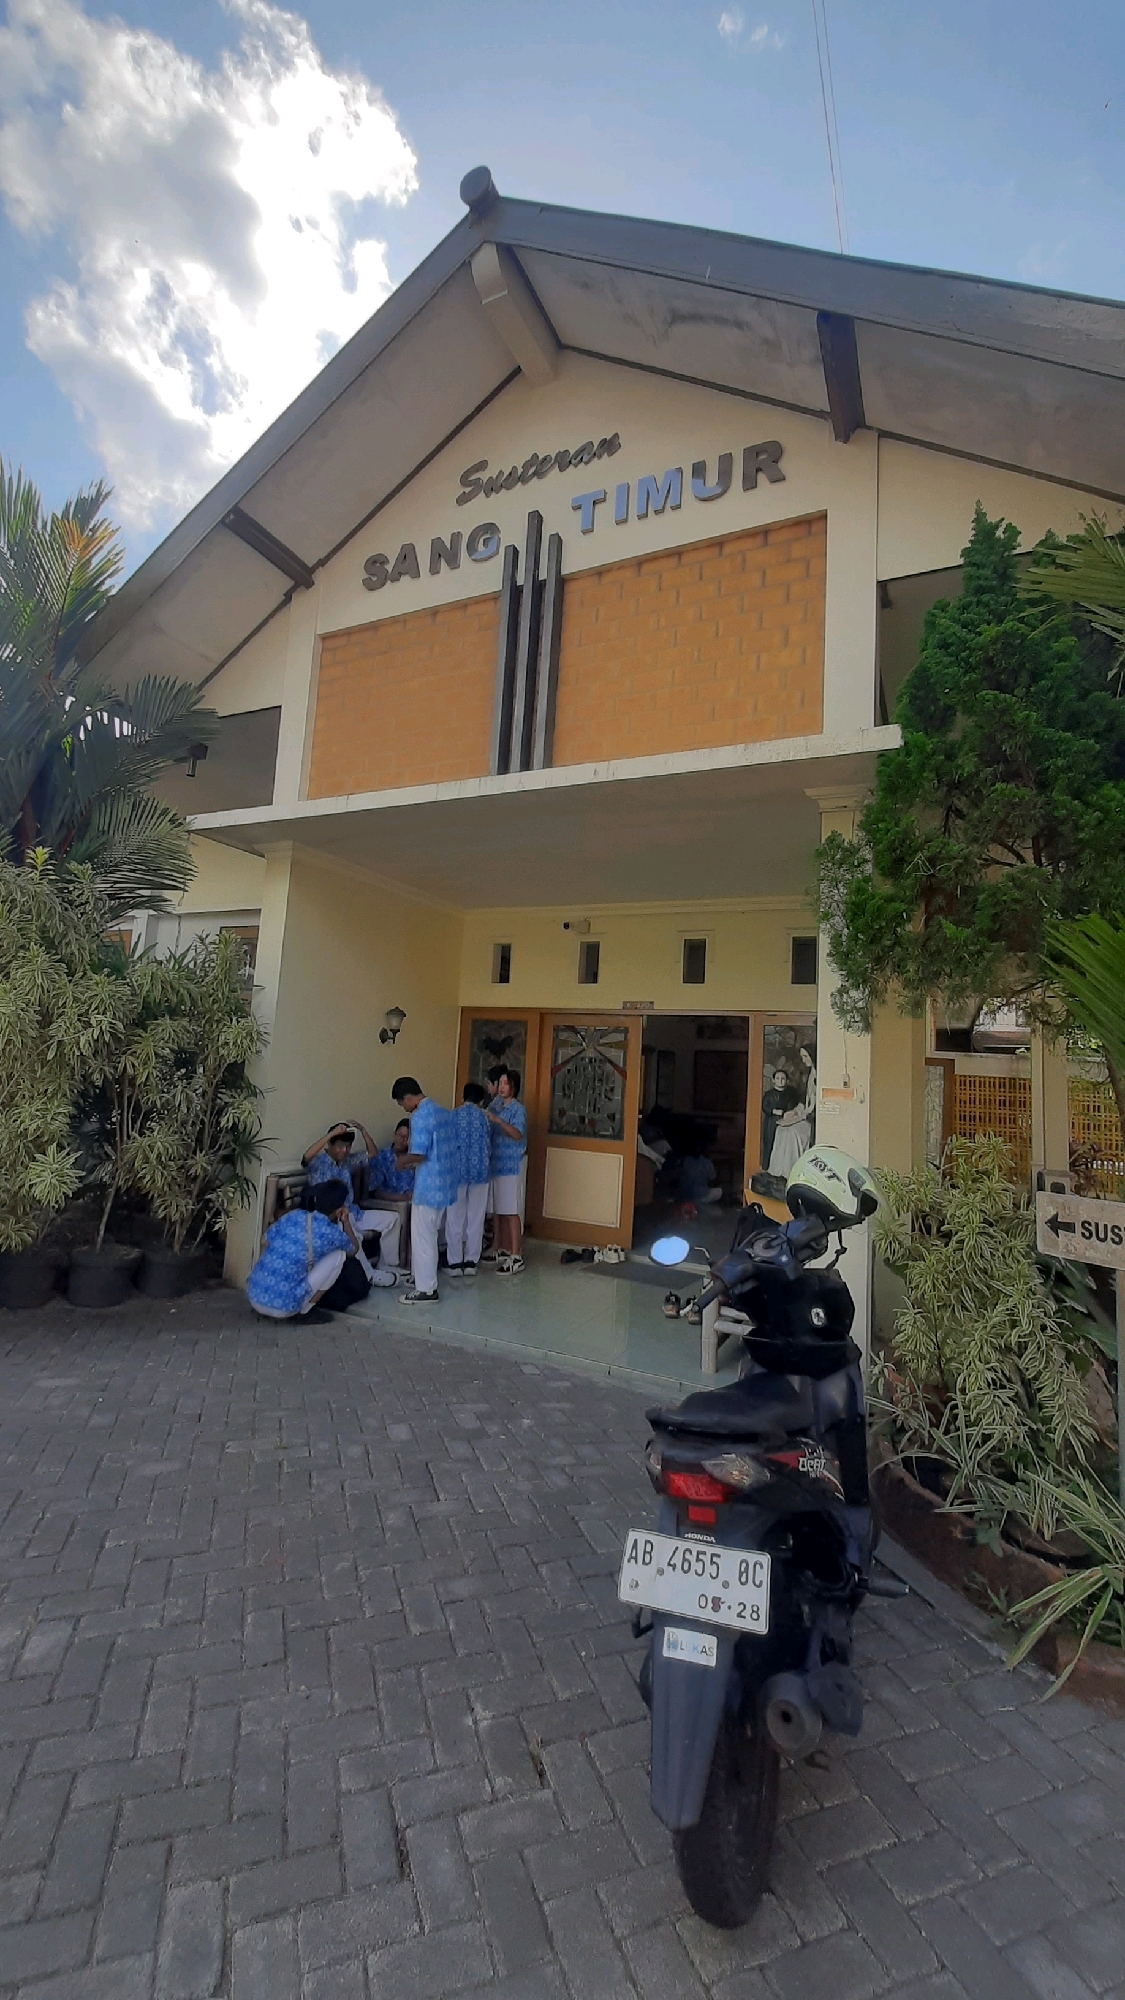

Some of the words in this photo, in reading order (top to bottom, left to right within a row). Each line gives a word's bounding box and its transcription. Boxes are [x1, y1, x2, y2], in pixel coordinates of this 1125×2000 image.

[455, 432, 621, 506] Susteran
[361, 522, 502, 591] SANG
[571, 440, 787, 535] TIMUR
[1081, 1220, 1125, 1246] SUS
[684, 1533, 717, 1543] HONDA
[627, 1538, 654, 1566] AB
[667, 1546, 721, 1580] 4655
[680, 1640, 715, 1657] LKAS
